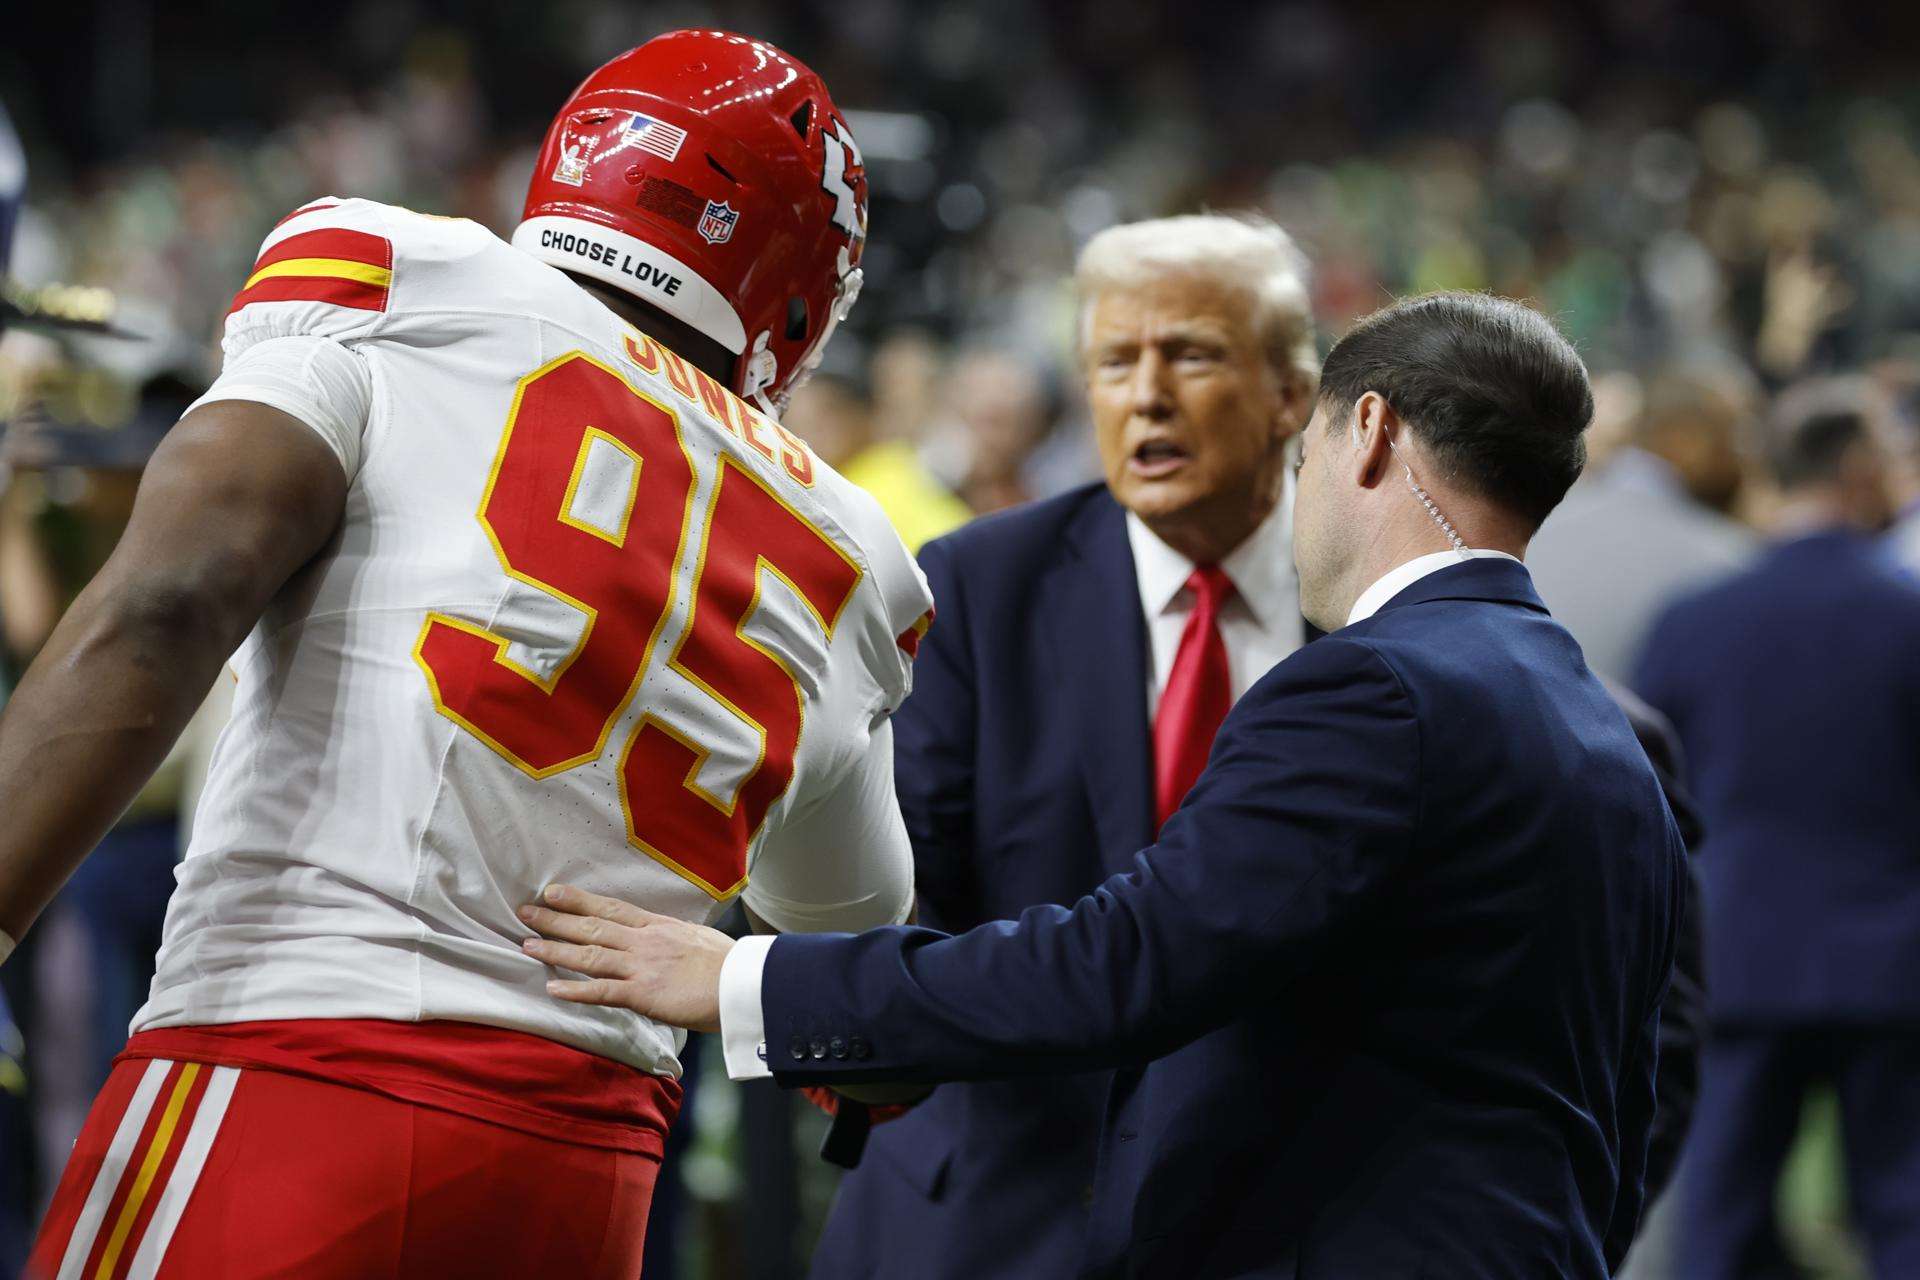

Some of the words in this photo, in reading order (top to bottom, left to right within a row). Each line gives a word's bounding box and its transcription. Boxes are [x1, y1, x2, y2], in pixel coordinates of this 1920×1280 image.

[541, 229, 618, 267] CHOOSE
[621, 255, 682, 297] LOVE
[703, 217, 728, 238] NFL
[623, 332, 816, 489] JONES
[412, 349, 864, 902] 95
